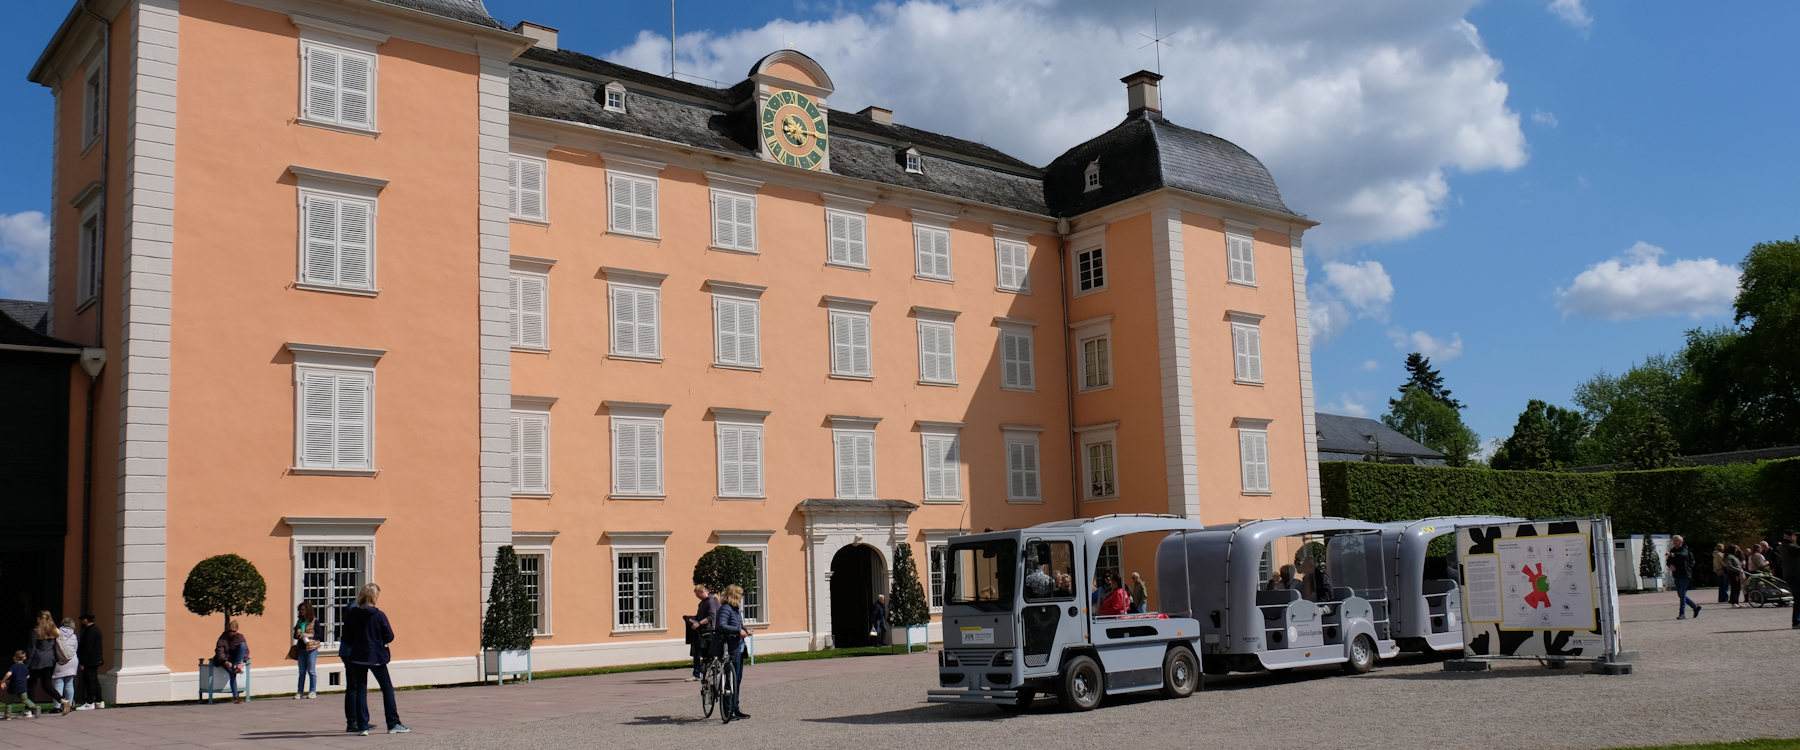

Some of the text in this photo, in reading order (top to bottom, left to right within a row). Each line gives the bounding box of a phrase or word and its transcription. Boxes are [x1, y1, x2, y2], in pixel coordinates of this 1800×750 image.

[775, 93, 786, 106] XI
[789, 92, 798, 106] XII
[765, 103, 778, 116] X
[804, 101, 811, 111] I
